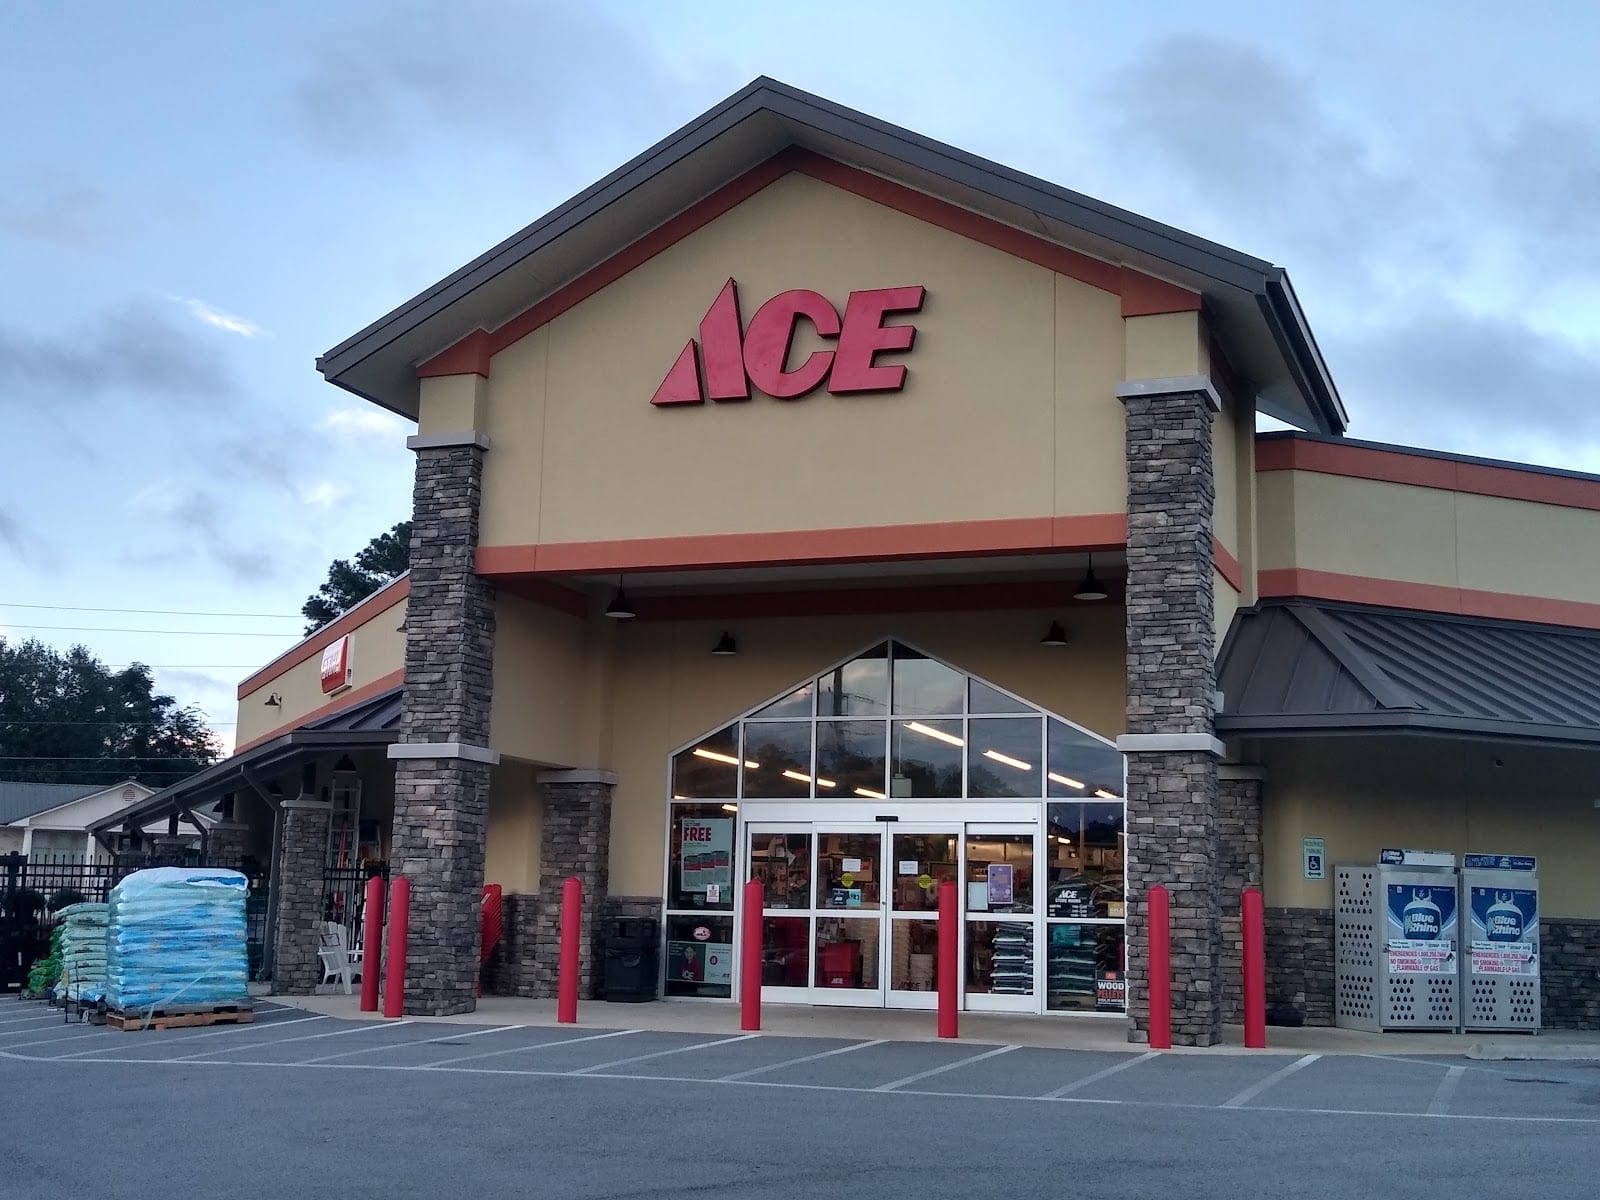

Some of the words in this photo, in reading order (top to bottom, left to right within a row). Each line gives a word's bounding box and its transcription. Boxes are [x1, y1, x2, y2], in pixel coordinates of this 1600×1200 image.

[650, 277, 926, 406] ACE
[684, 827, 712, 841] FREE
[1058, 890, 1078, 898] ACE
[1411, 913, 1435, 923] Blue
[1494, 915, 1517, 925] Blue
[1409, 923, 1438, 933] Rhino
[1492, 925, 1521, 935] Rhino
[1098, 982, 1124, 990] WOOD
[1098, 990, 1123, 998] PELLETS
